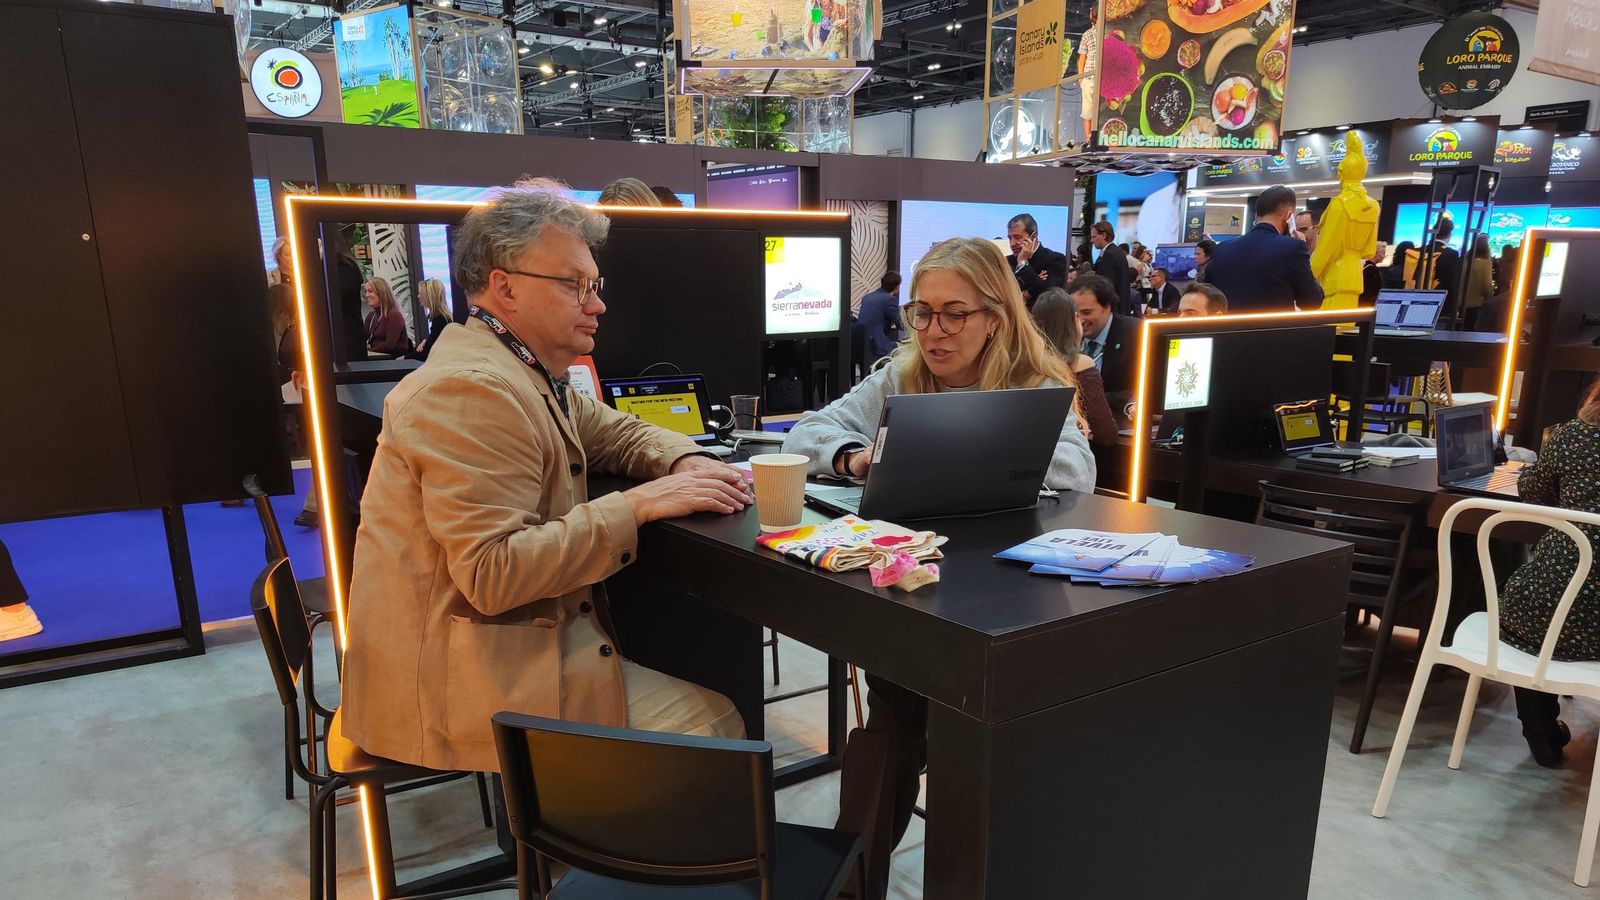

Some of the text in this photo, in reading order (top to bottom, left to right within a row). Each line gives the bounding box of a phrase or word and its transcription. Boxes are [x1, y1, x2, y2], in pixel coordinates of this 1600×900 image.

[1020, 27, 1046, 43] Canary
[1020, 39, 1044, 55] Islands
[1446, 54, 1512, 64] LORO PARQUE
[1410, 151, 1472, 161] LORO PARQUE
[765, 240, 777, 251] 27
[772, 299, 832, 311] sierranevada
[1049, 537, 1126, 550] VIVELA
